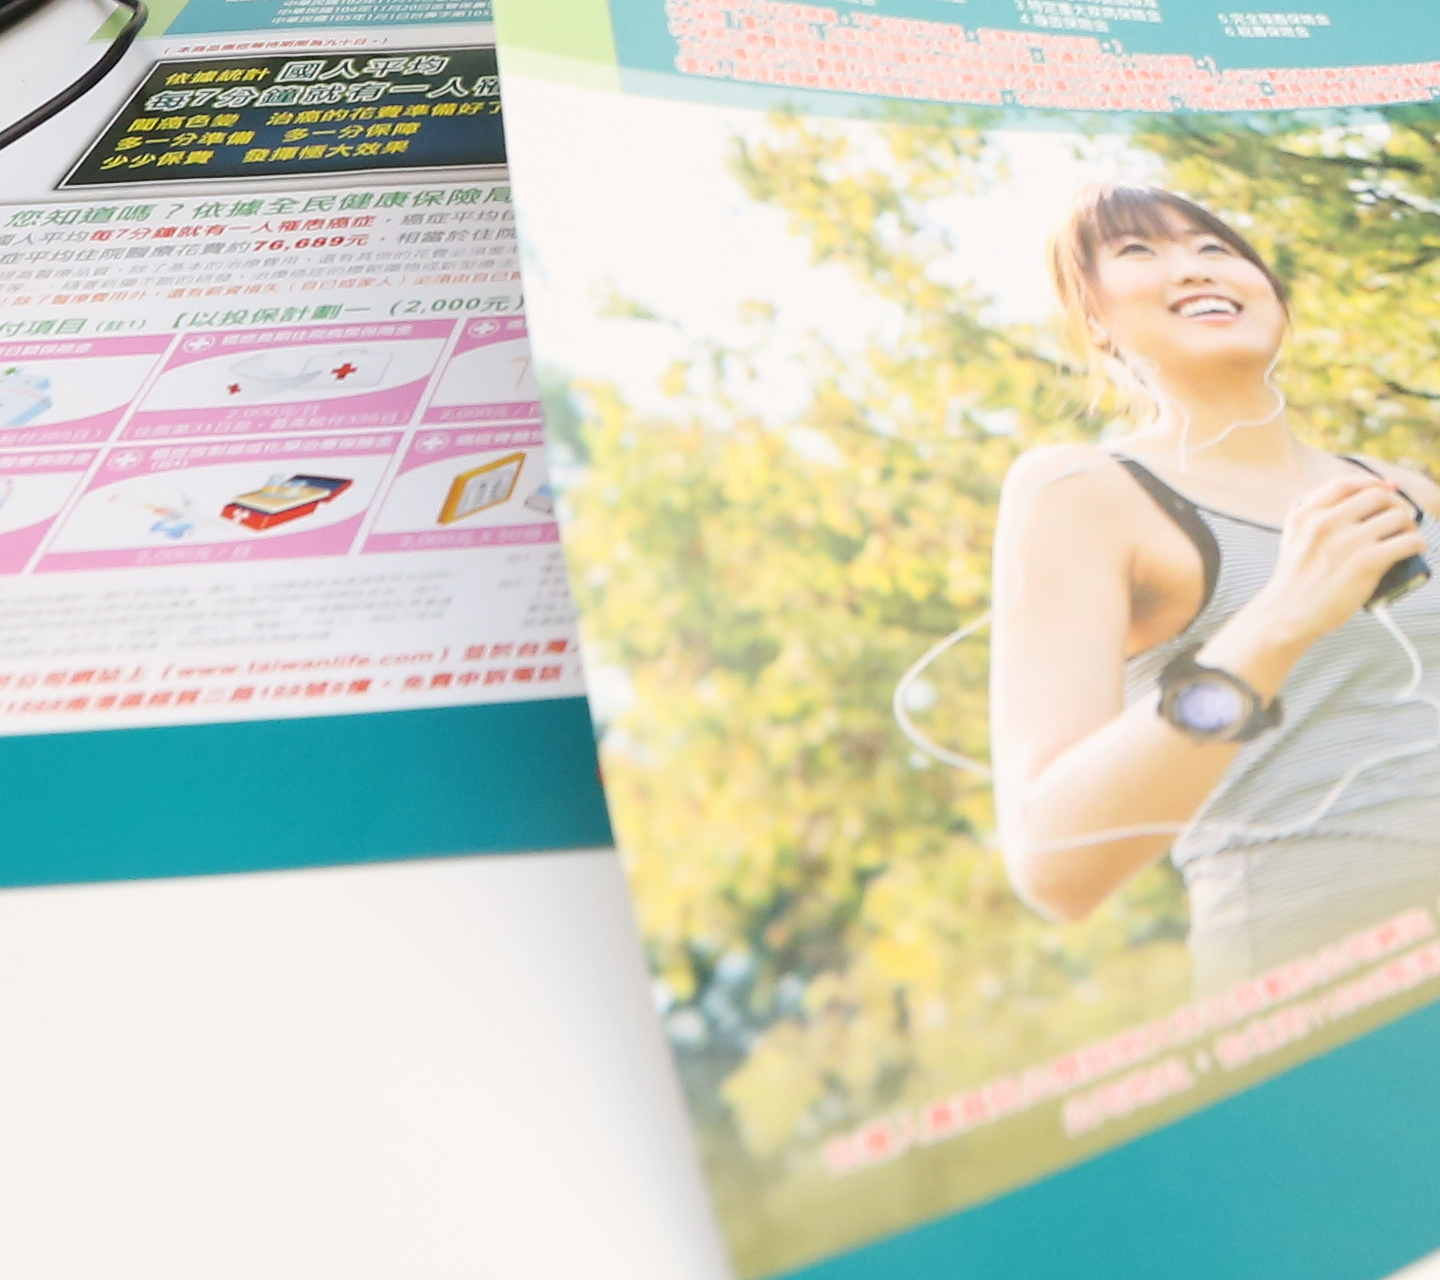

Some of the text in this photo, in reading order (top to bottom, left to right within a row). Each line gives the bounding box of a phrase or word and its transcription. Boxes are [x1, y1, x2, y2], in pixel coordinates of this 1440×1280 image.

[163, 54, 447, 87] 依據統計 國人平均
[114, 120, 423, 152] 多一分準備 多一分保障
[100, 139, 411, 172] 少少保費 發揮極大效果
